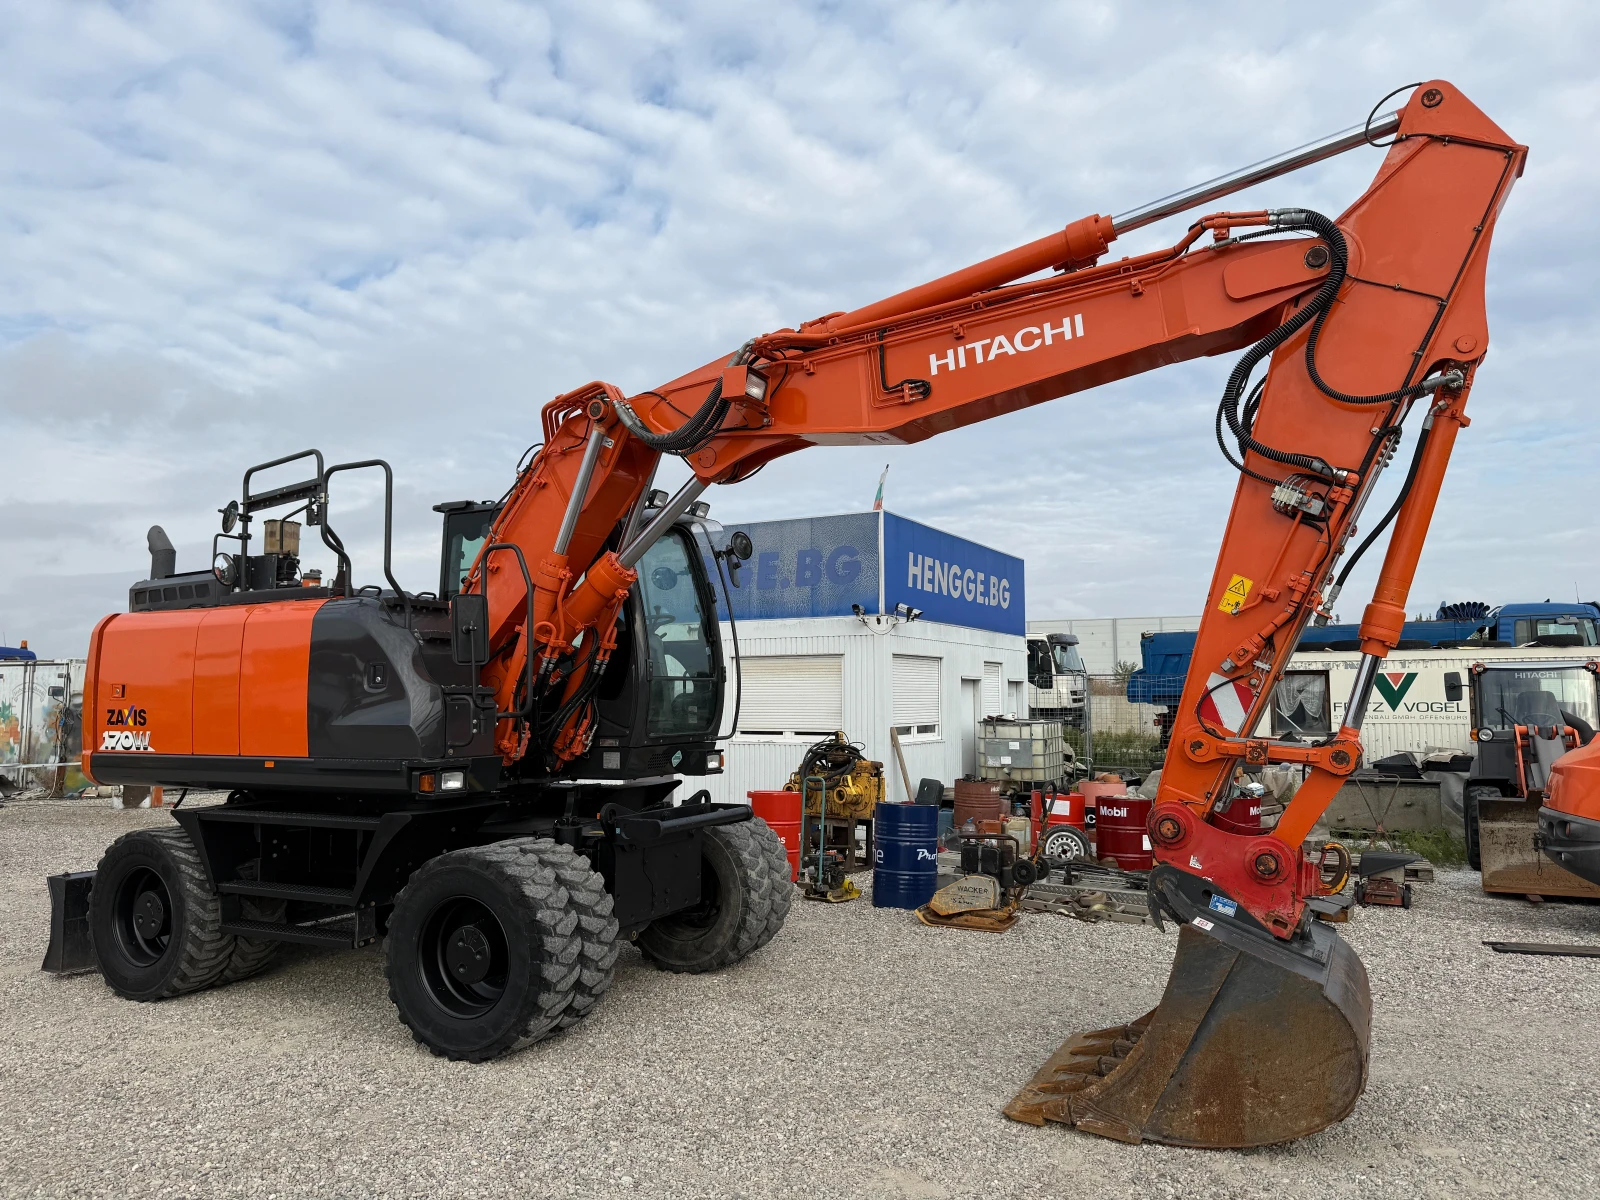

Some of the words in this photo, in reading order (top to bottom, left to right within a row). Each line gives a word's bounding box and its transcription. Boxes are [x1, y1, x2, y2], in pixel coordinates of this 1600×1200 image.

[929, 313, 1085, 376] HITACHI
[907, 551, 1010, 610] HENGGE.BG
[1514, 671, 1558, 679] HITACHI
[1403, 701, 1467, 713] VOGEL
[106, 704, 147, 727] ZAXIS
[101, 730, 152, 751] 170W
[1100, 805, 1127, 817] Mobil
[957, 885, 989, 894] WACKER
